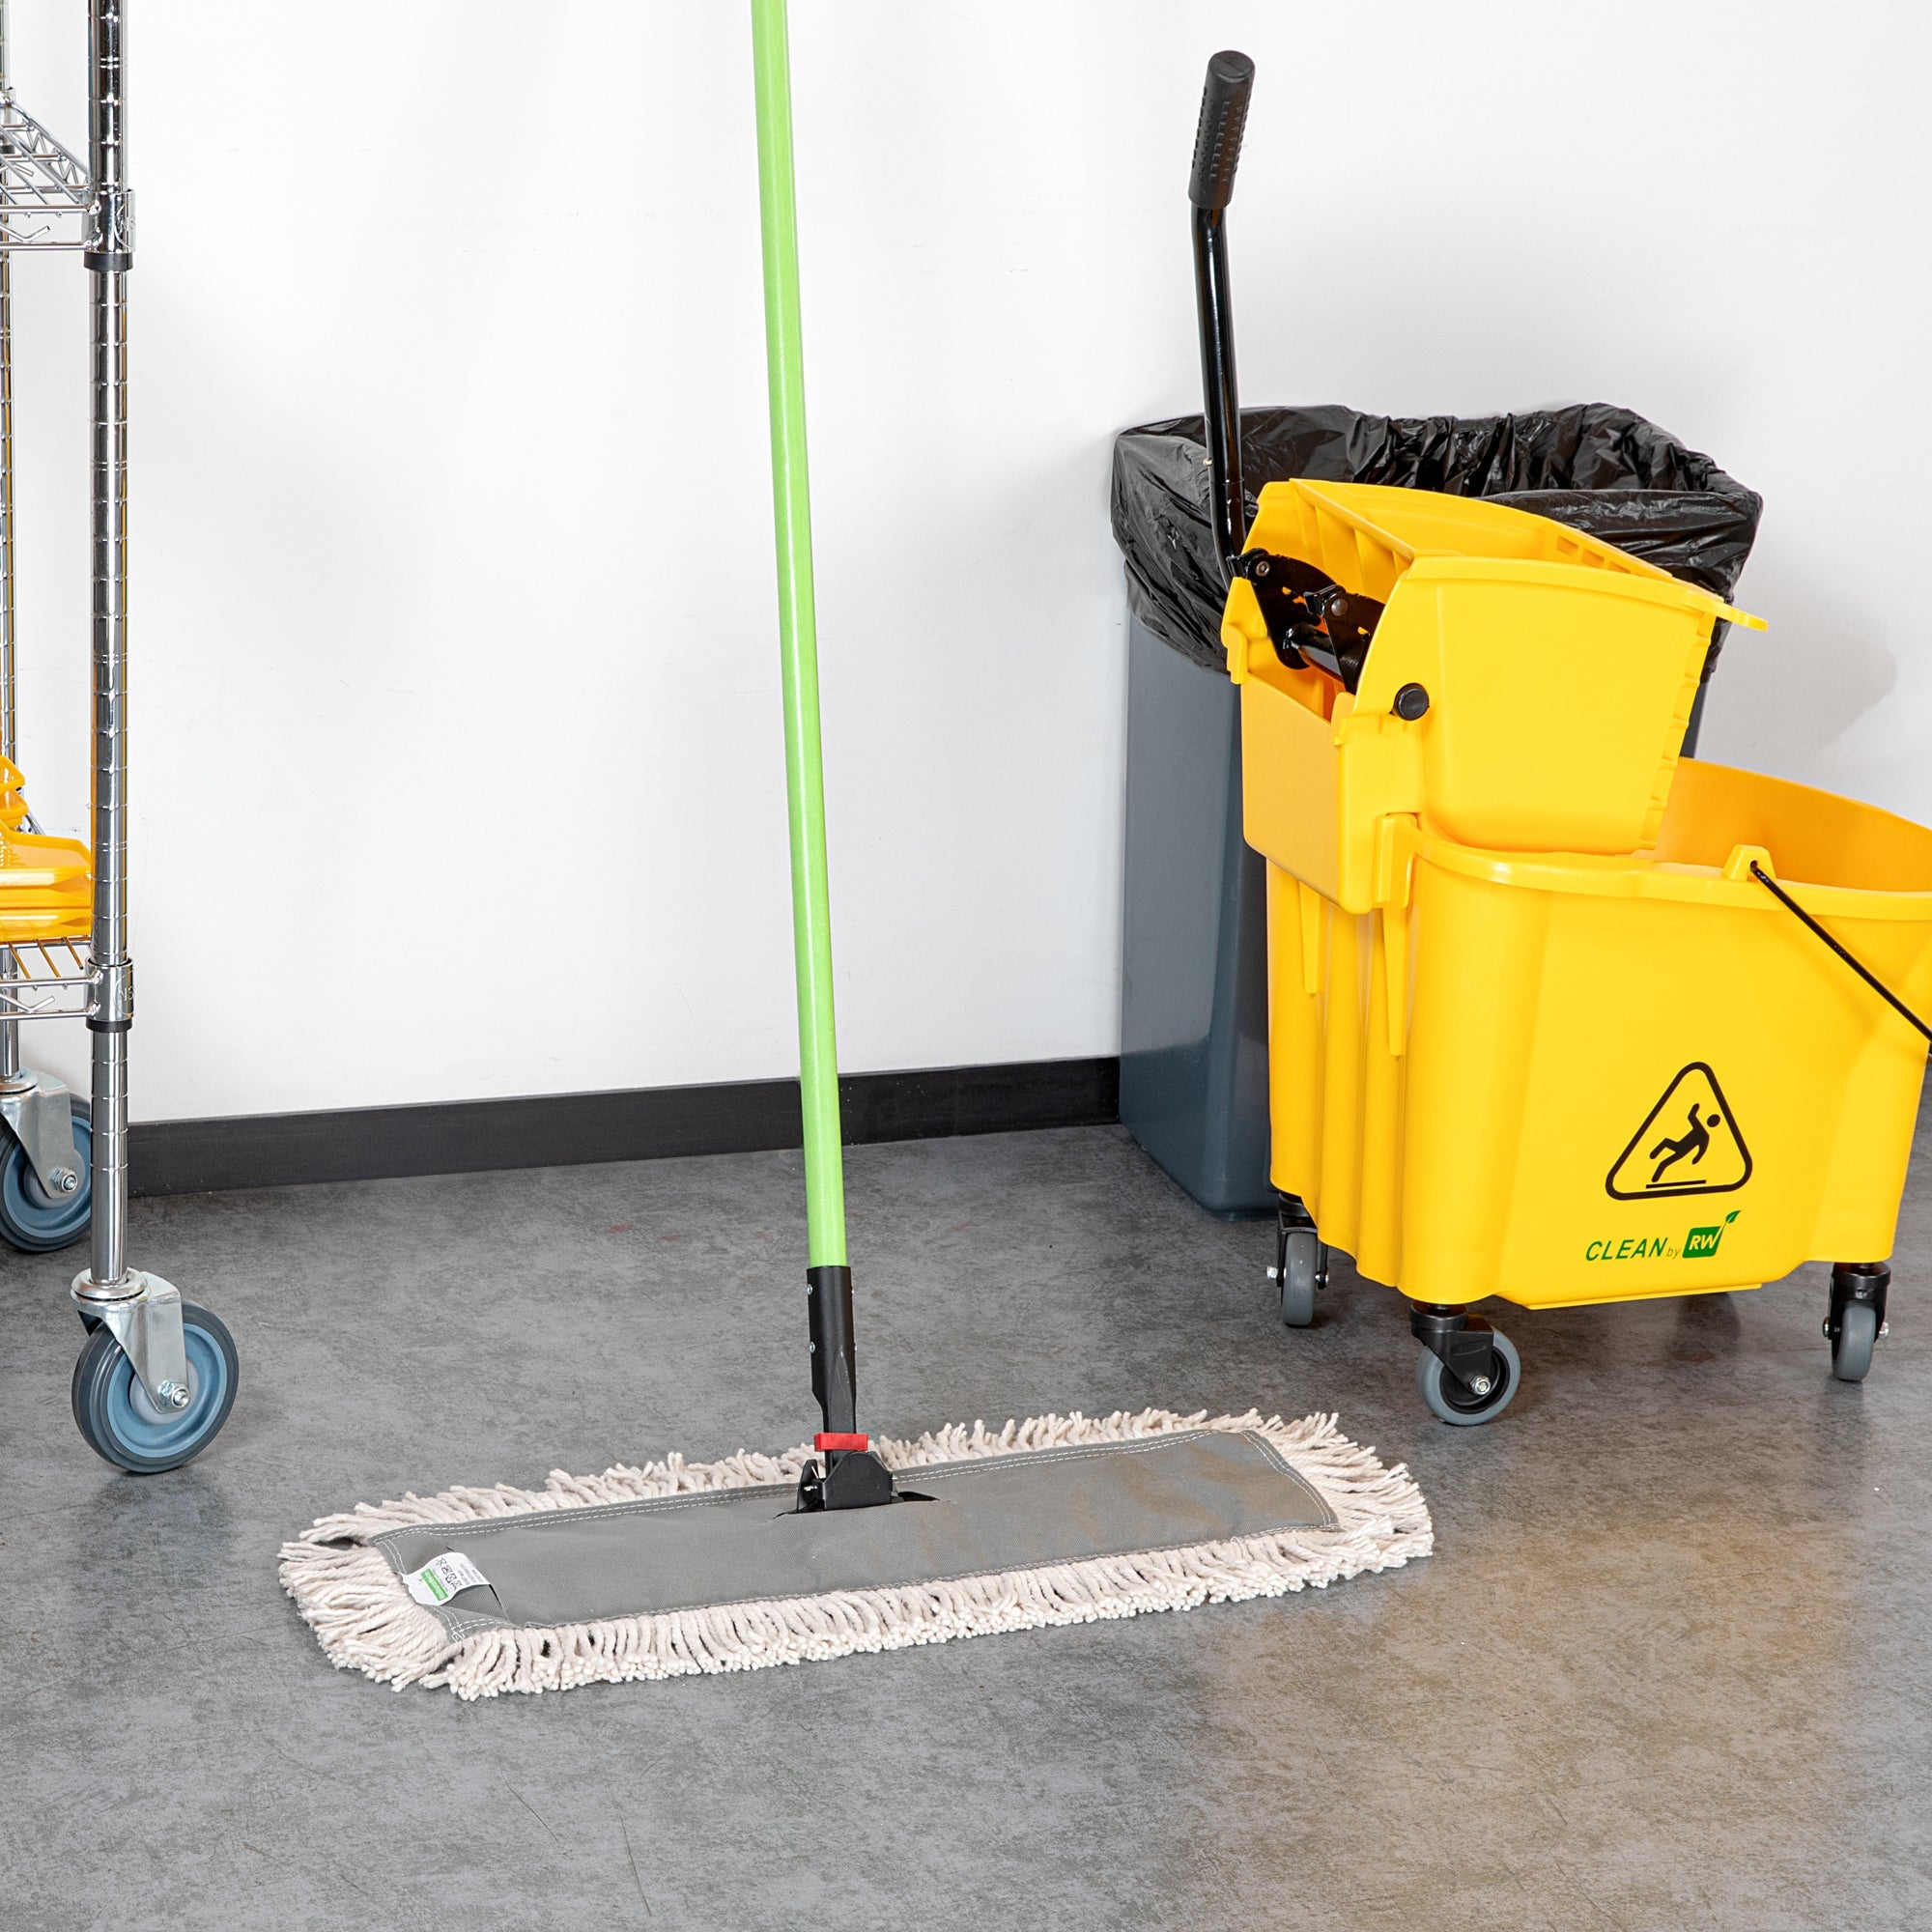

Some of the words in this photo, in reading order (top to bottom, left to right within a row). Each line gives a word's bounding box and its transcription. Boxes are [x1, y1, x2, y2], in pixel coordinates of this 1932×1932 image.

[1586, 1237, 1668, 1261] CLEAN
[1666, 1246, 1681, 1260] by
[1689, 1233, 1719, 1251] RW
